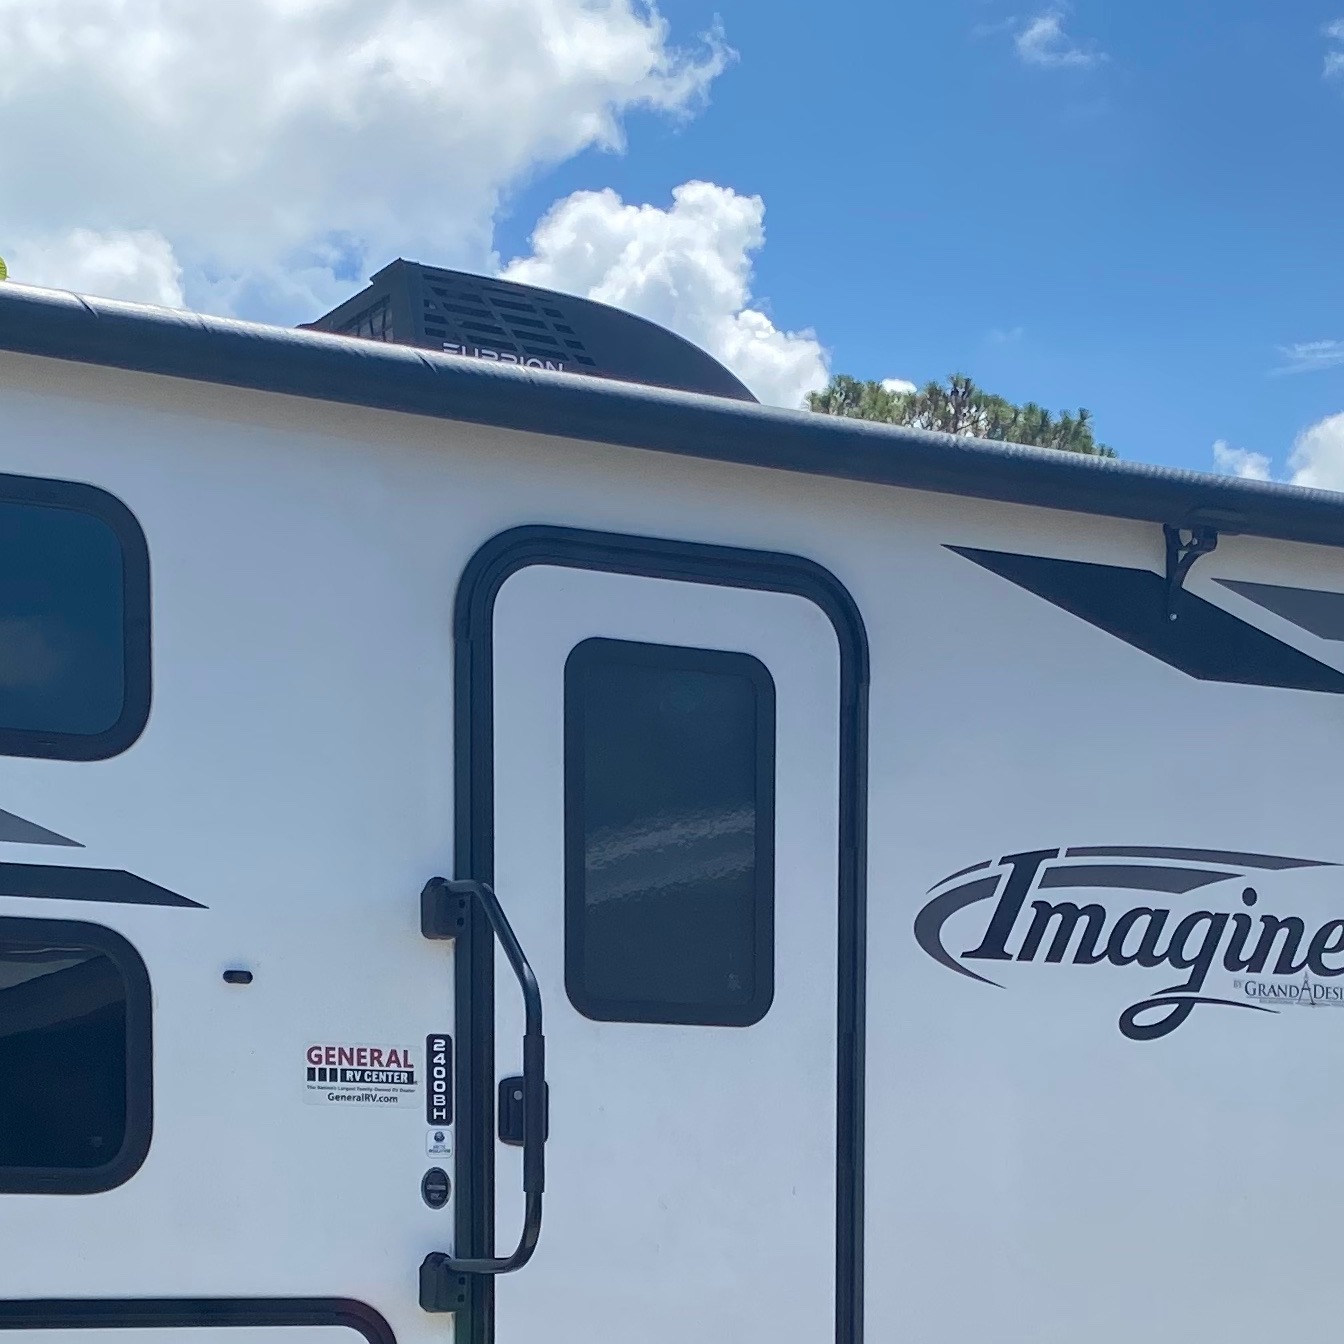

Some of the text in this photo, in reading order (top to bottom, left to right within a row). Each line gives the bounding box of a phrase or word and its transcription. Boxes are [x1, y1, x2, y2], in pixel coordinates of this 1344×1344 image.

[1244, 980, 1300, 997] GRAND
[306, 1045, 415, 1069] GENERAL
[346, 1070, 409, 1084] RV CENTER
[433, 1038, 447, 1120] 2400BH
[327, 1092, 399, 1104] GeneralRV.com
